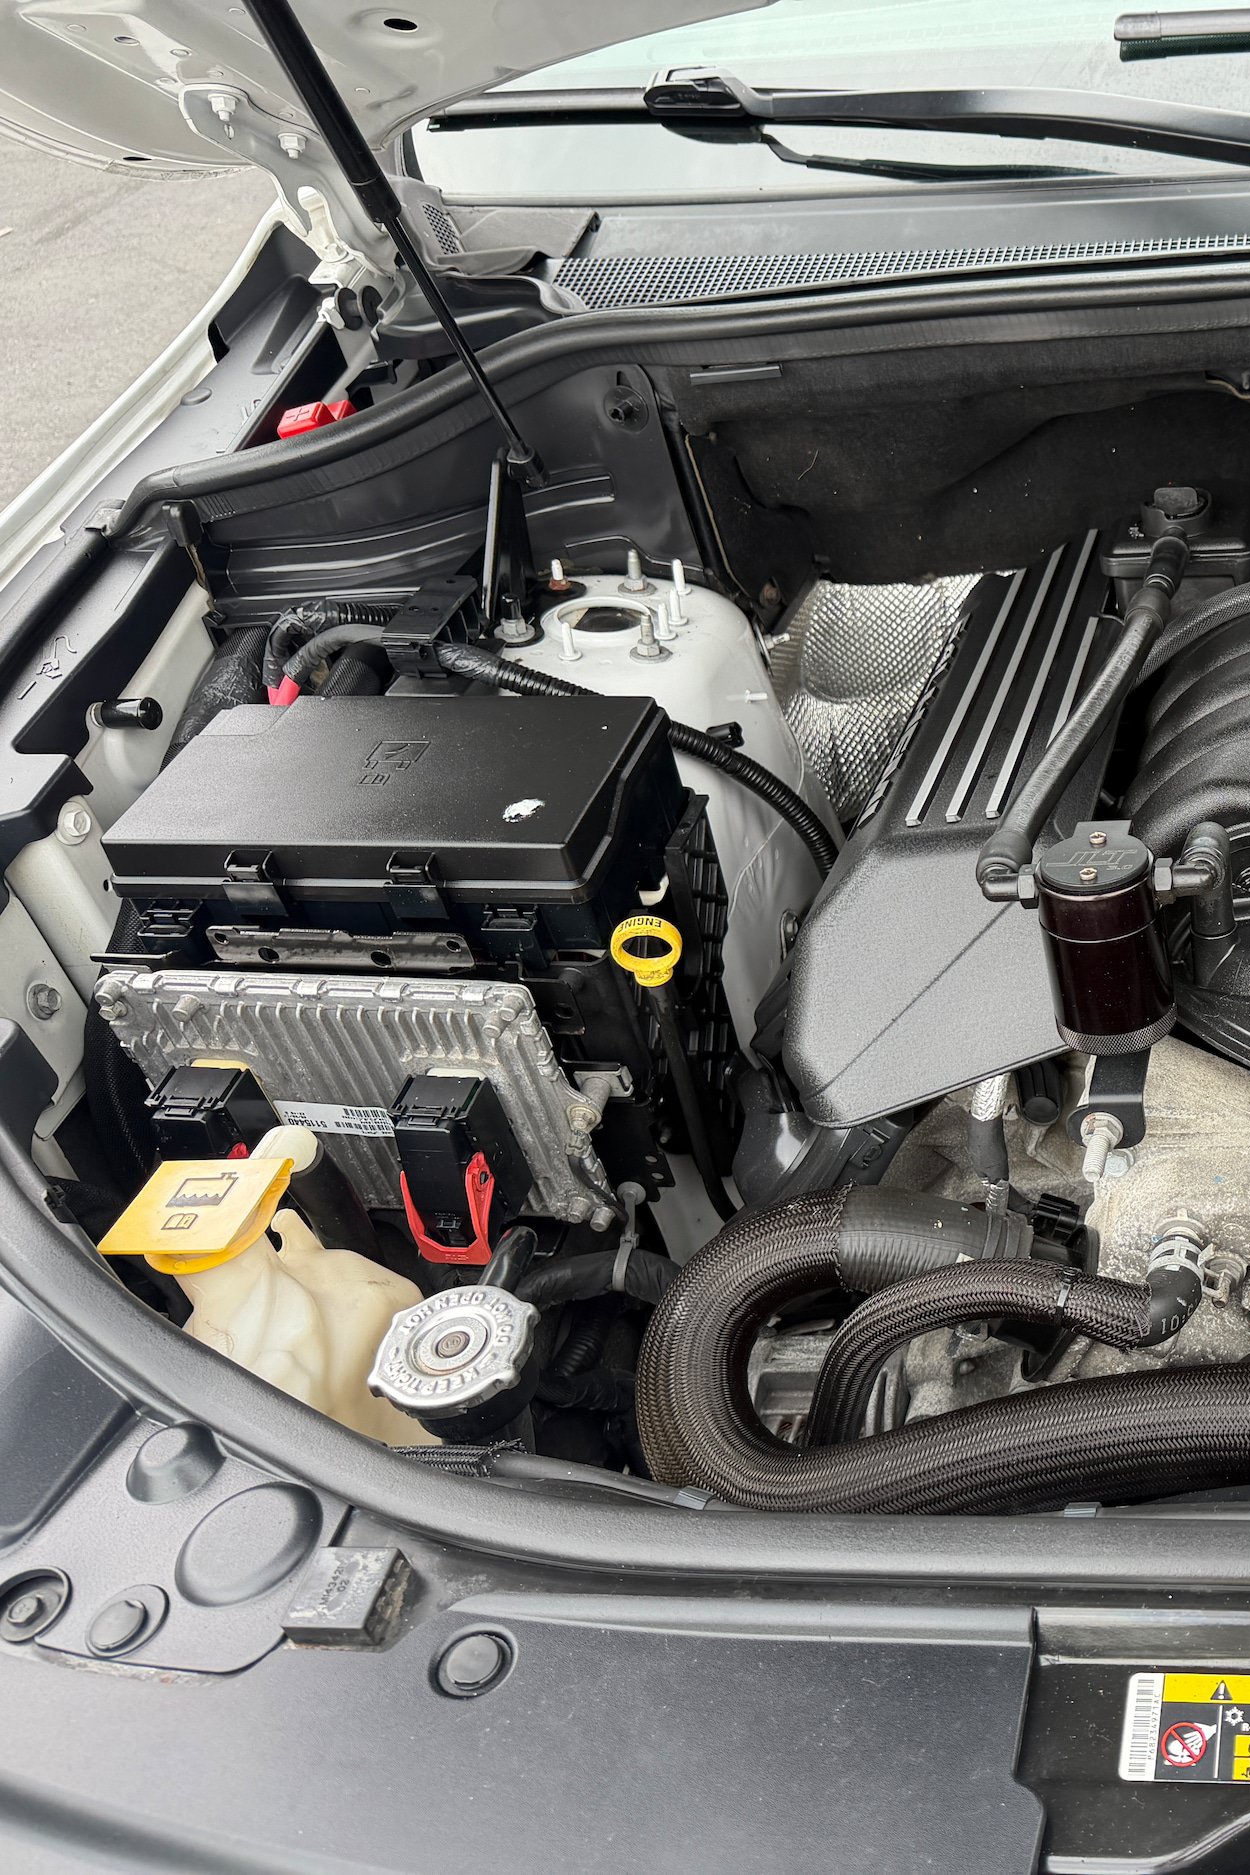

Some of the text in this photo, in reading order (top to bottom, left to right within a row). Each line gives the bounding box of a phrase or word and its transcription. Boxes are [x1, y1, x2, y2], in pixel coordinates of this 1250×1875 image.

[1046, 849, 1138, 868] JLT
[617, 917, 663, 933] ENGINE
[287, 1118, 328, 1129] 5115440
[435, 1291, 487, 1310] OPEN
[398, 1306, 435, 1336] HOT
[424, 1367, 481, 1396] KEEP
